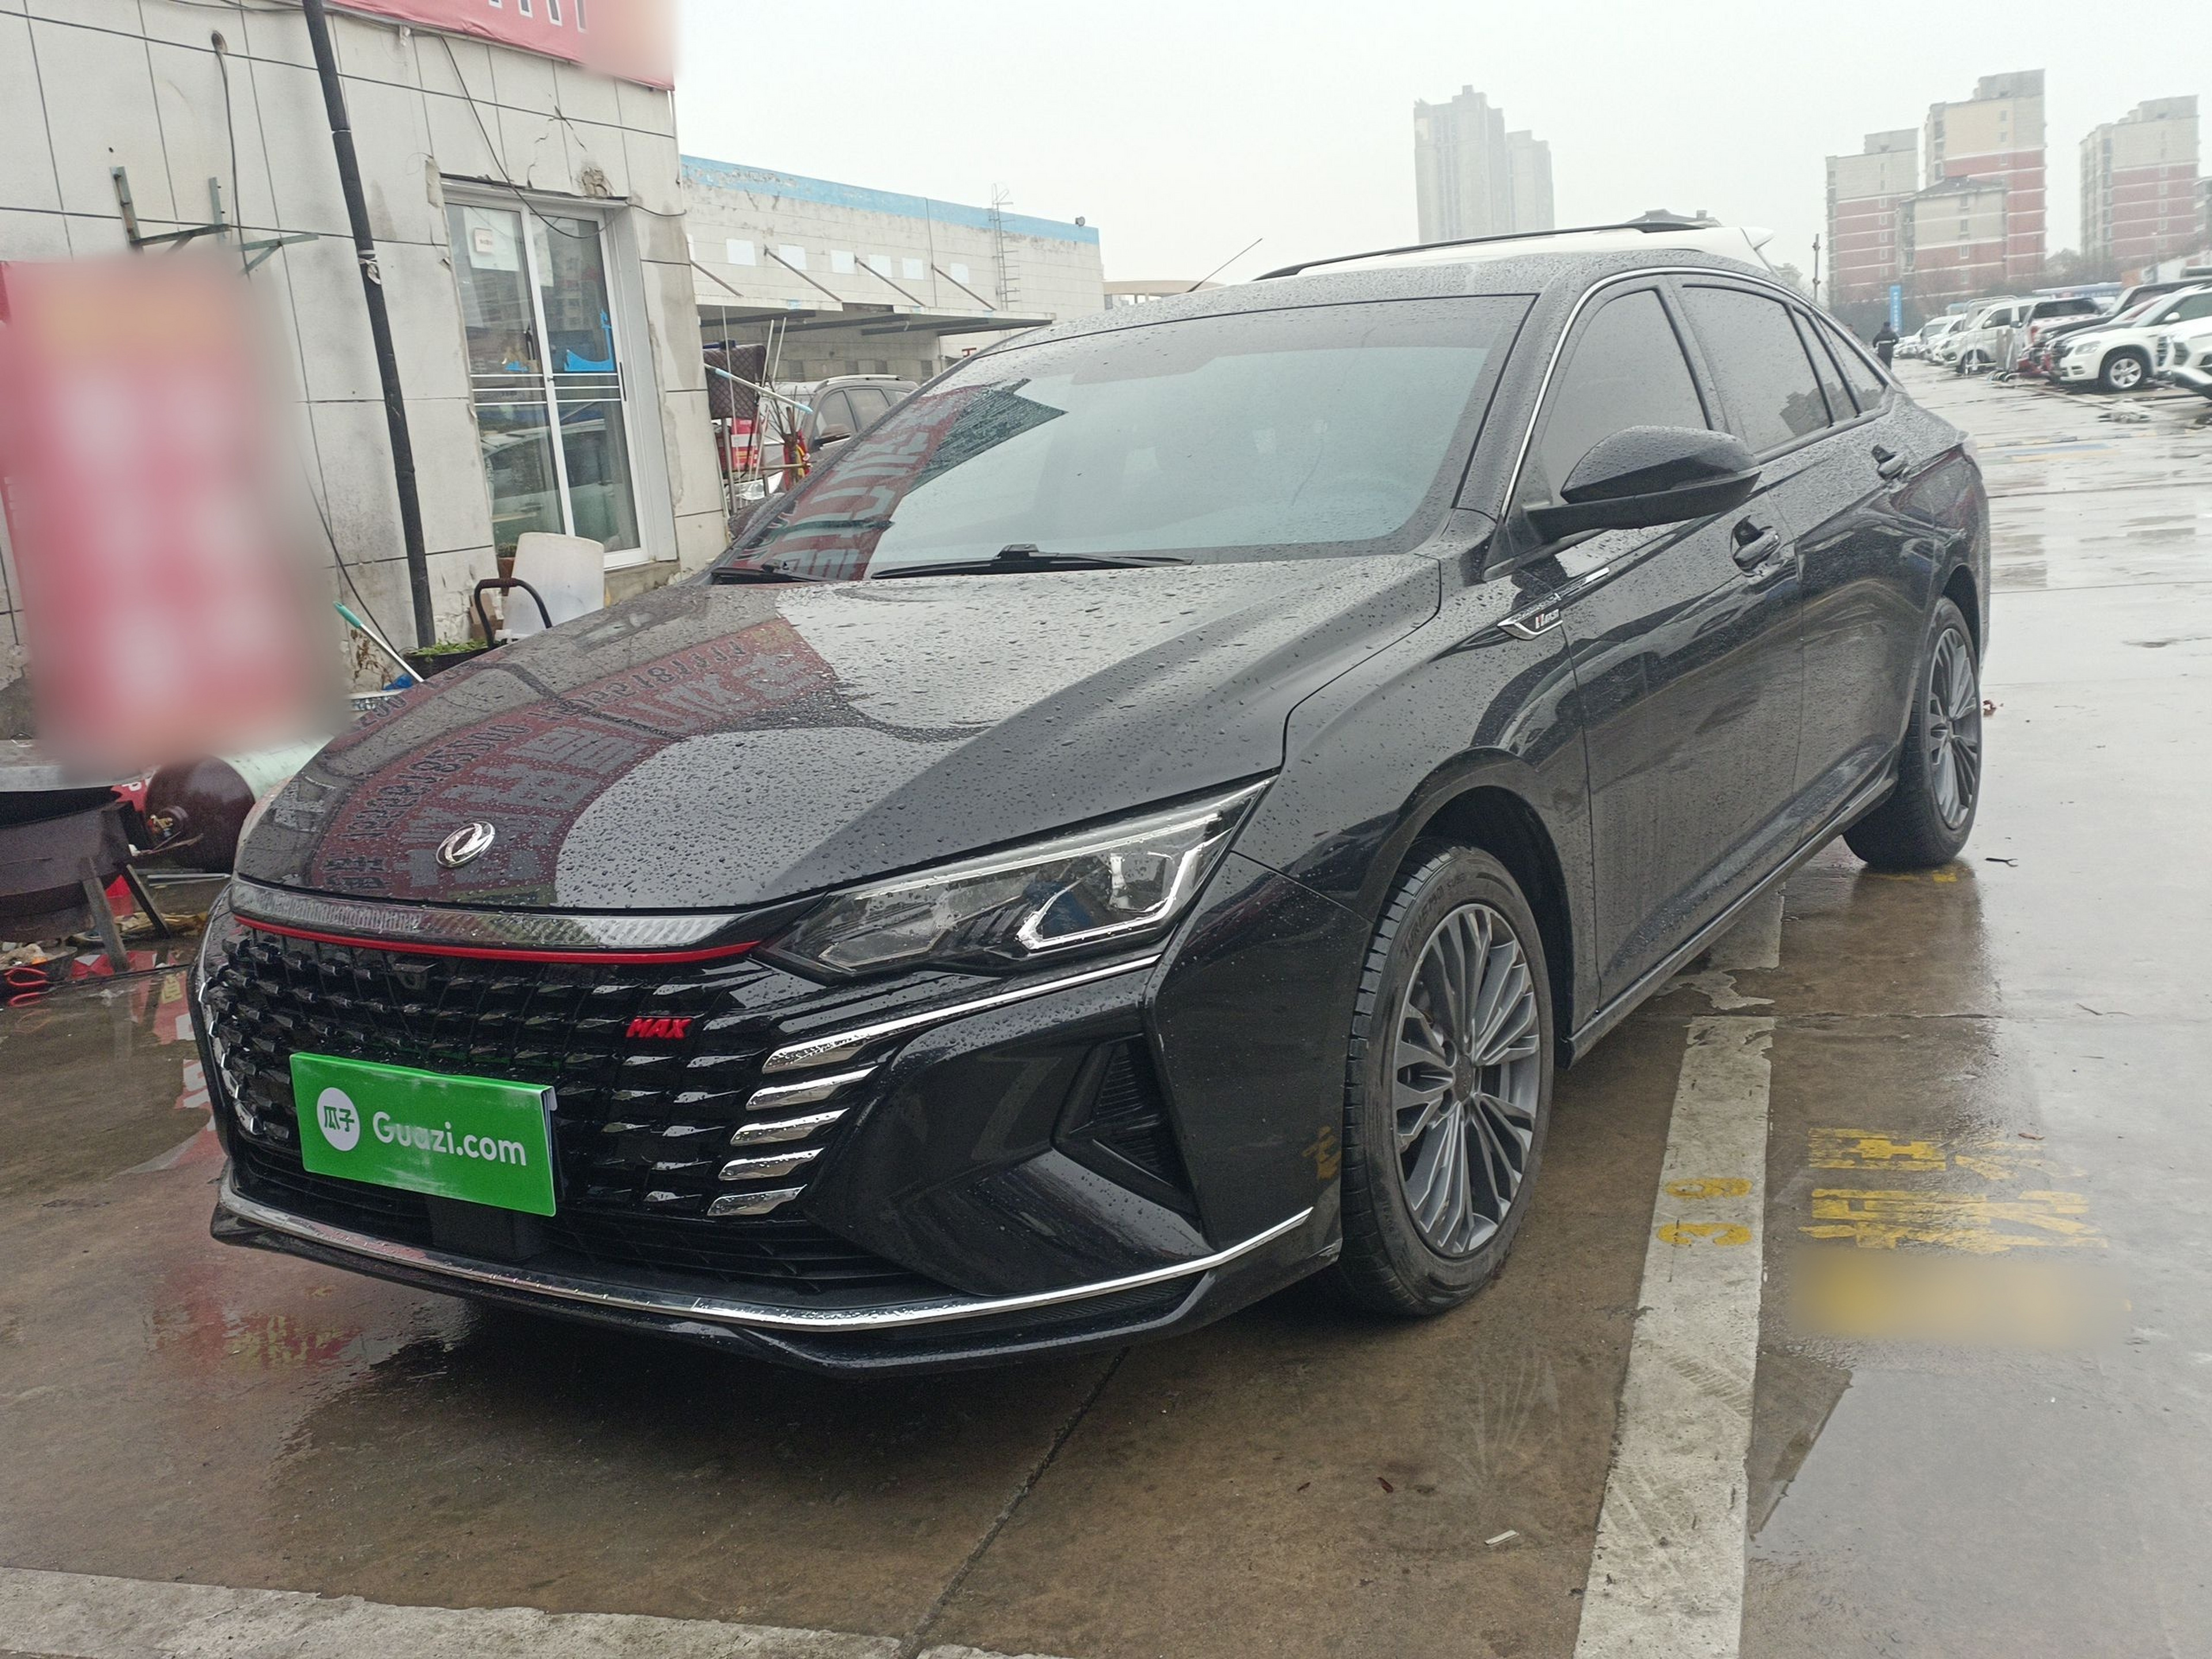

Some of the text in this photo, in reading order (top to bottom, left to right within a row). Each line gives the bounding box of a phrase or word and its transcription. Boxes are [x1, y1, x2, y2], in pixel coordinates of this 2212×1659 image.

[626, 1018, 692, 1039] MAX
[324, 1105, 355, 1132] 瓜子
[373, 1111, 527, 1166] Guazi.com
